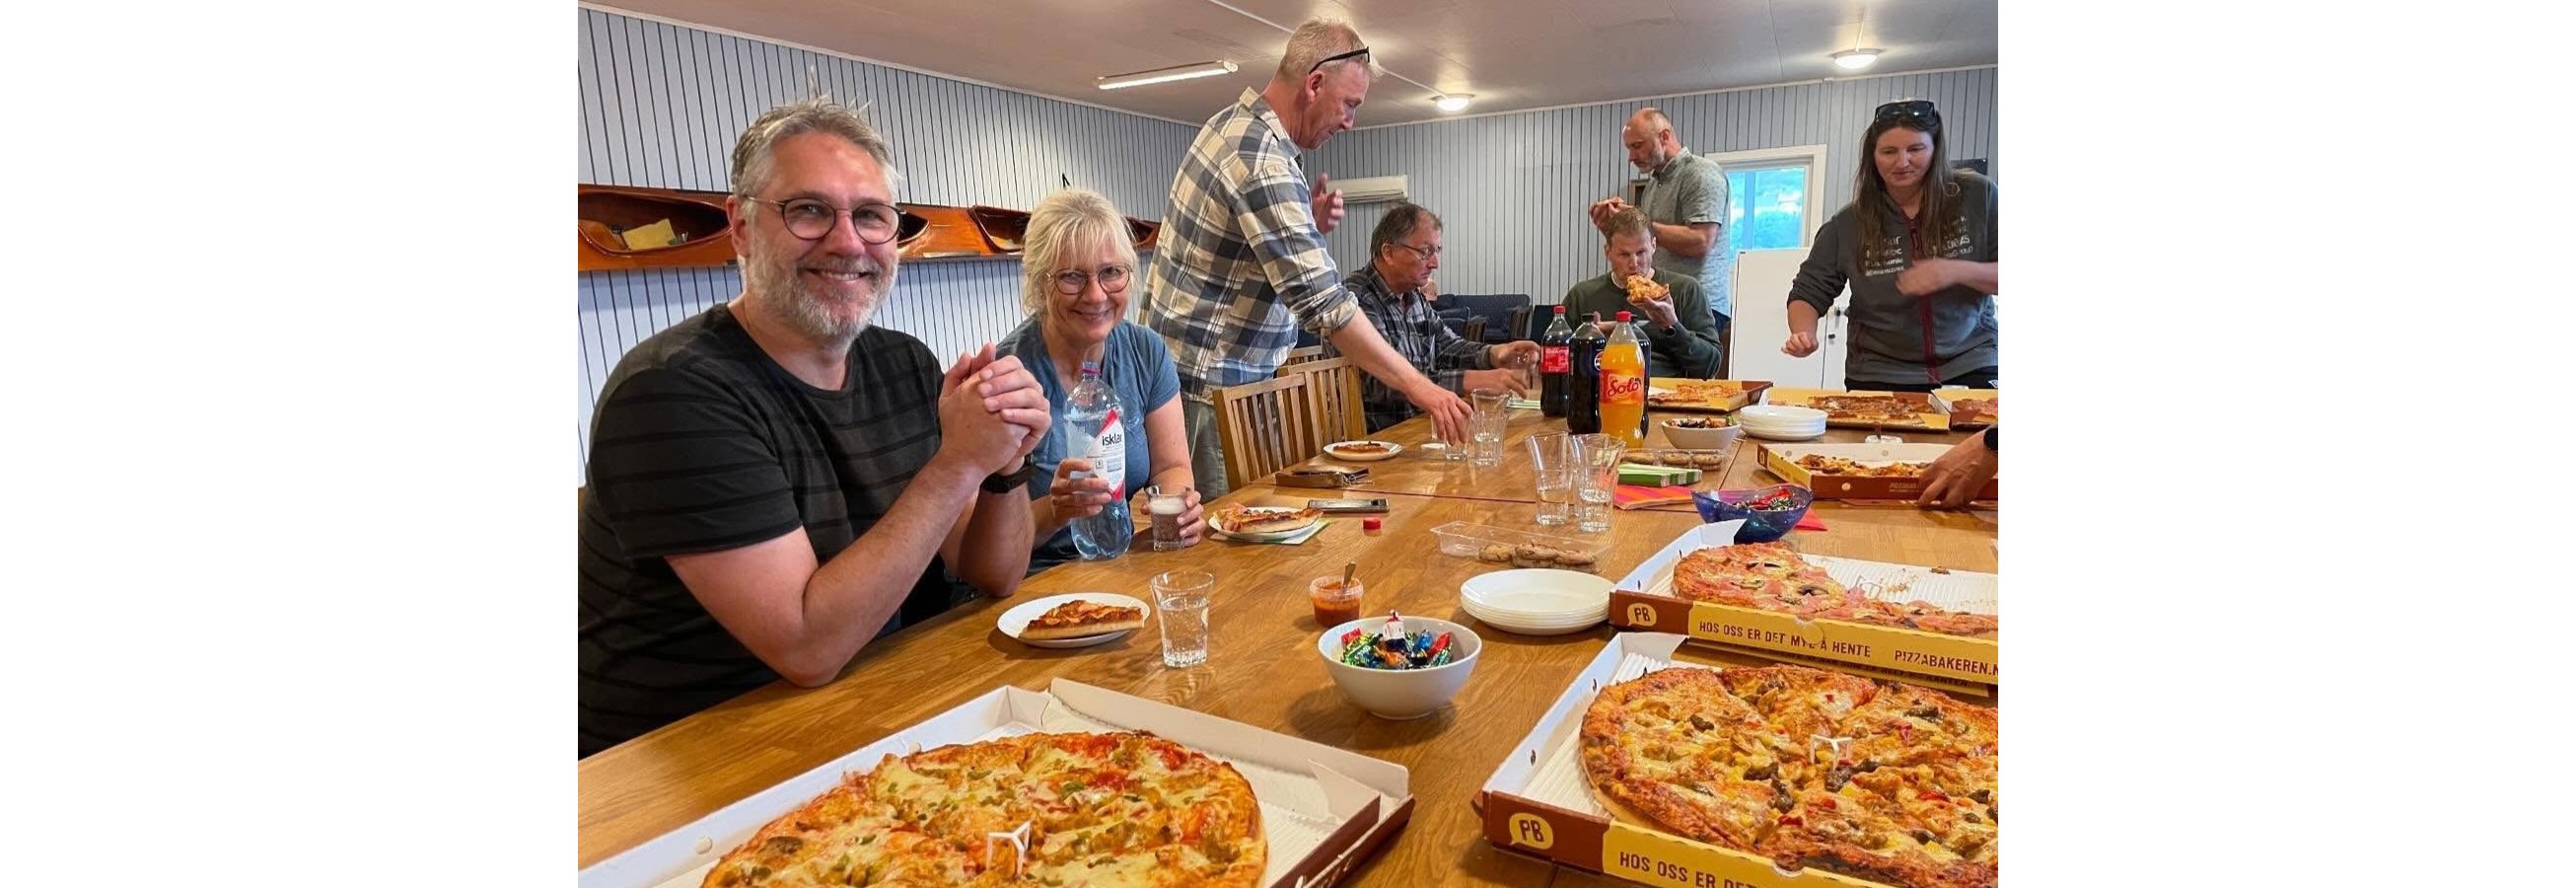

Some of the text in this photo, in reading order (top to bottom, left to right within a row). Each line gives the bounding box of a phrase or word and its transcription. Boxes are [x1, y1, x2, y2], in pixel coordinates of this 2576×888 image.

[1608, 377, 1640, 397] Solo
[1102, 432, 1122, 446] iskla
[1633, 607, 1651, 623] PB
[1699, 622, 1719, 633] HOS
[1723, 625, 1744, 637] OSS
[1748, 628, 1761, 640] ER
[1764, 630, 1786, 643] DET
[1790, 634, 1817, 649] MY
[1831, 641, 1871, 658] HENTE
[1519, 819, 1544, 843] PB
[1619, 851, 1651, 872] HOS
[1657, 860, 1688, 883] OSS
[1695, 871, 1716, 888] ER
